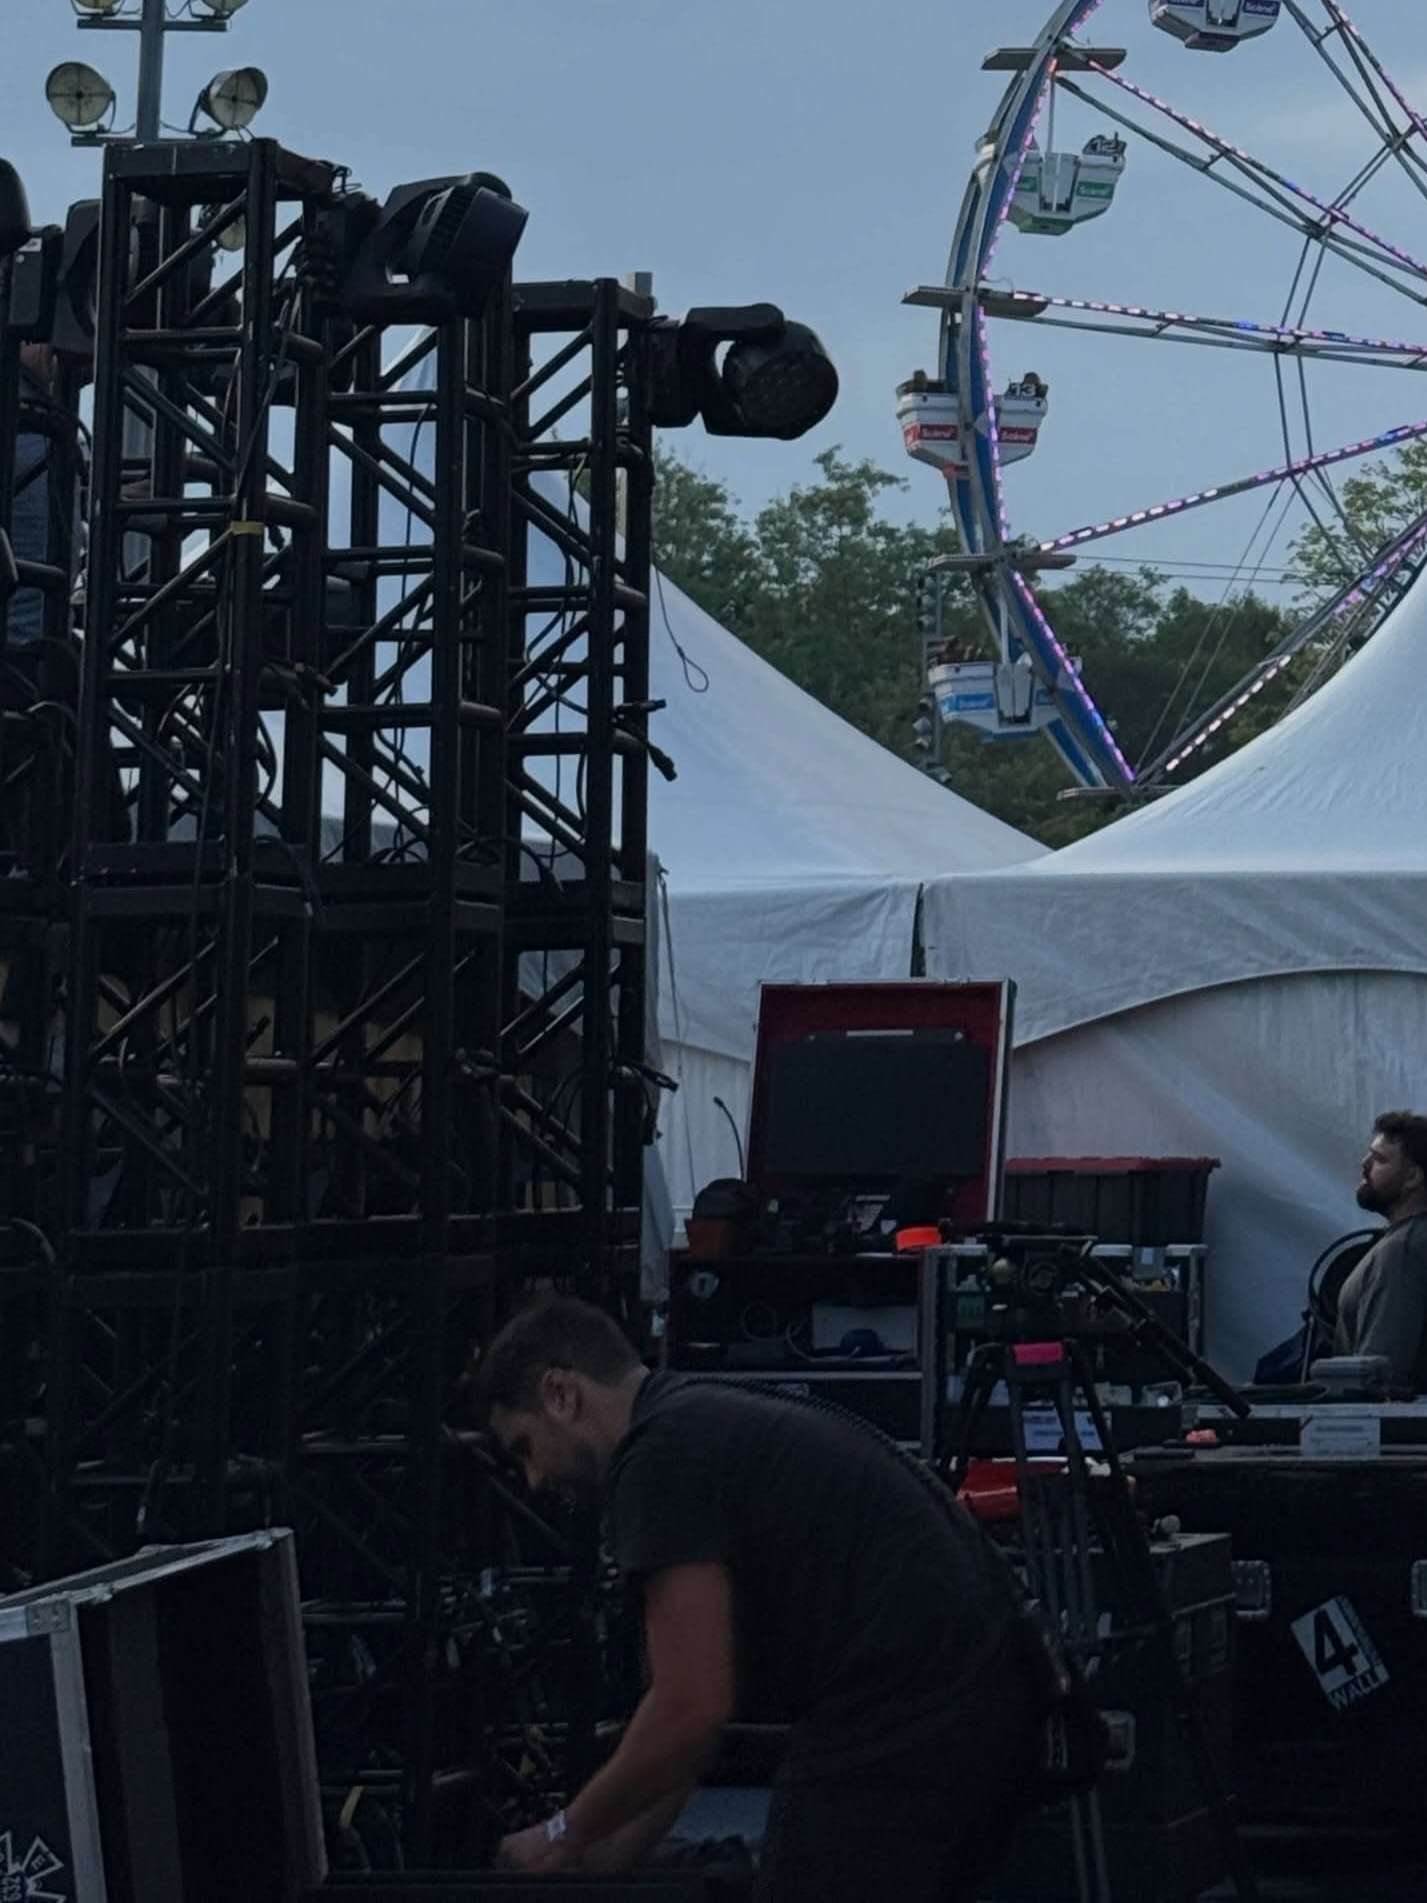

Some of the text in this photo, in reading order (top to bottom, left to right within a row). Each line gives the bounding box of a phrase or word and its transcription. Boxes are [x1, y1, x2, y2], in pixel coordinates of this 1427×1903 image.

[1011, 383, 1036, 396] 13
[1314, 1609, 1358, 1675] 4
[1327, 1670, 1379, 1714] WALL
